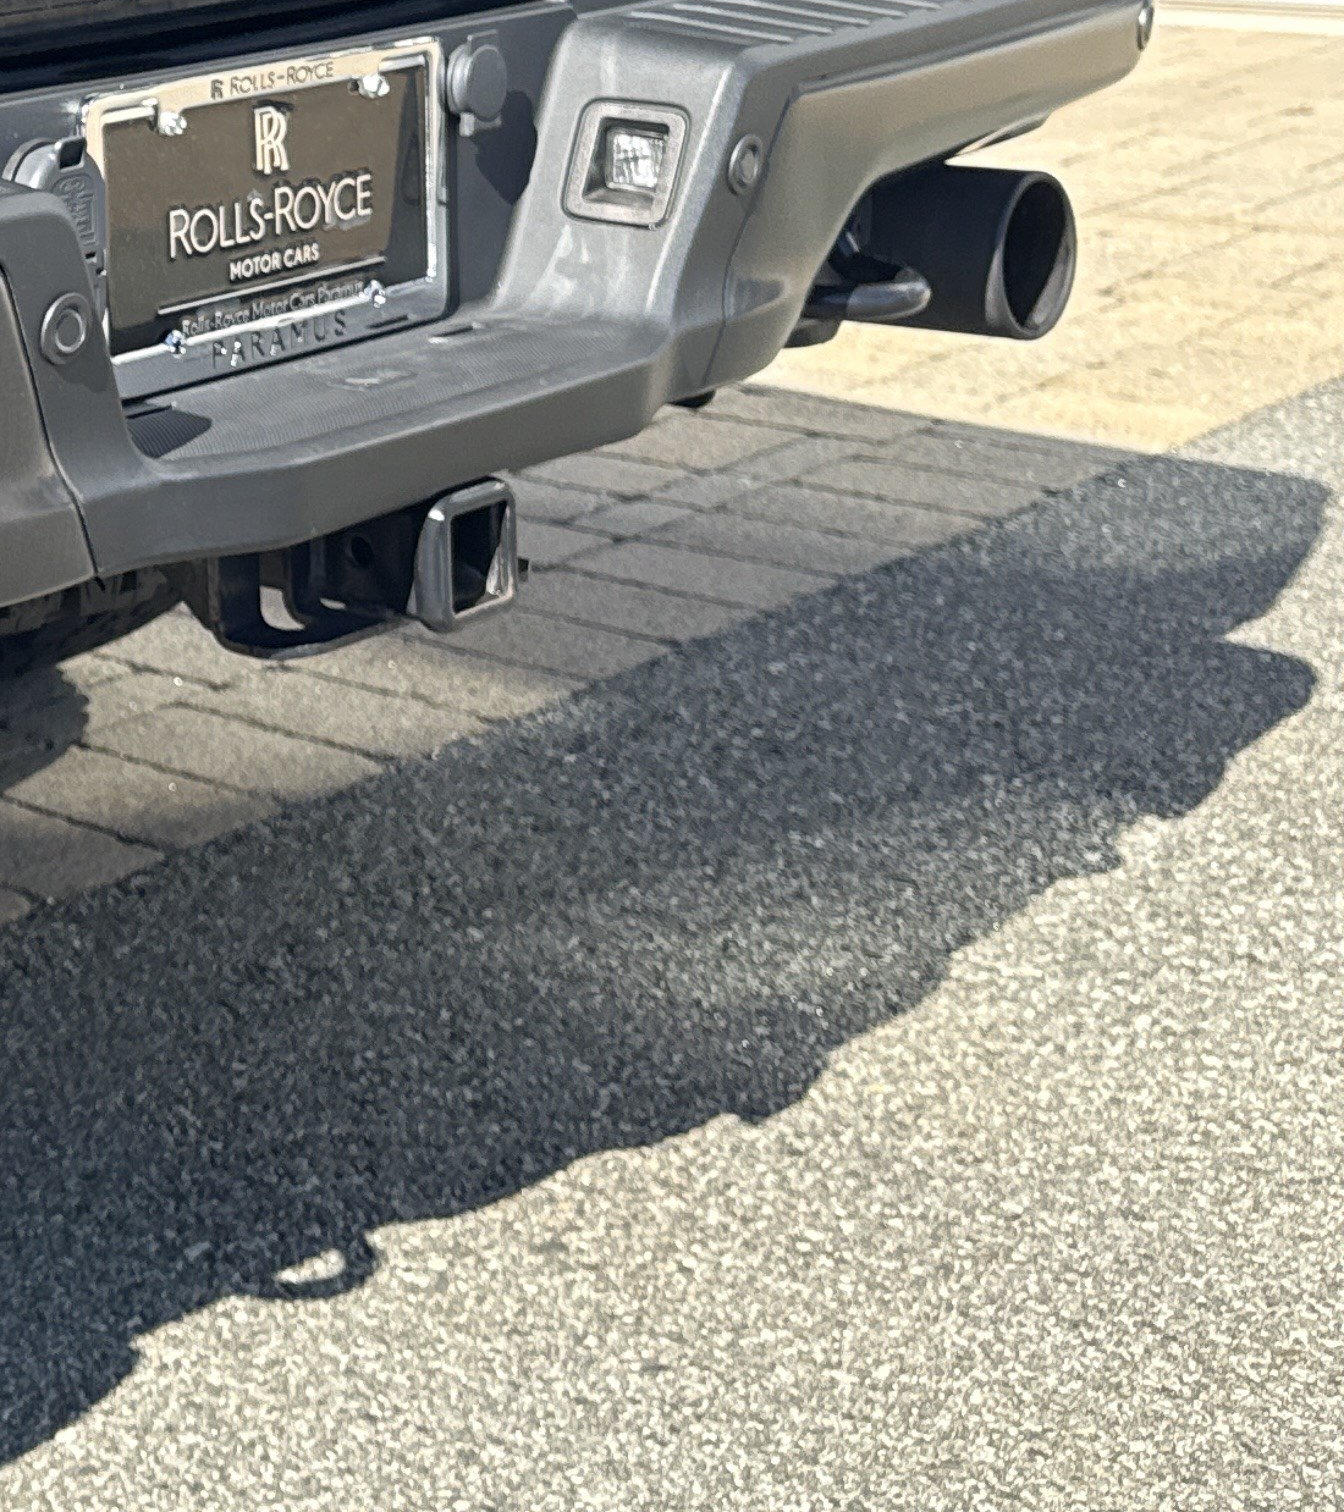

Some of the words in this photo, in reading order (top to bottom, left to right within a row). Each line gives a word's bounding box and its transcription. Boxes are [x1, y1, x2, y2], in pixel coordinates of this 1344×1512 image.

[230, 61, 334, 96] ROLLS-ROYCE
[168, 173, 373, 259] ROLLS-ROYCE
[229, 252, 282, 281] MOTOR
[283, 242, 319, 267] CARS
[211, 309, 347, 369] PARAMUS
